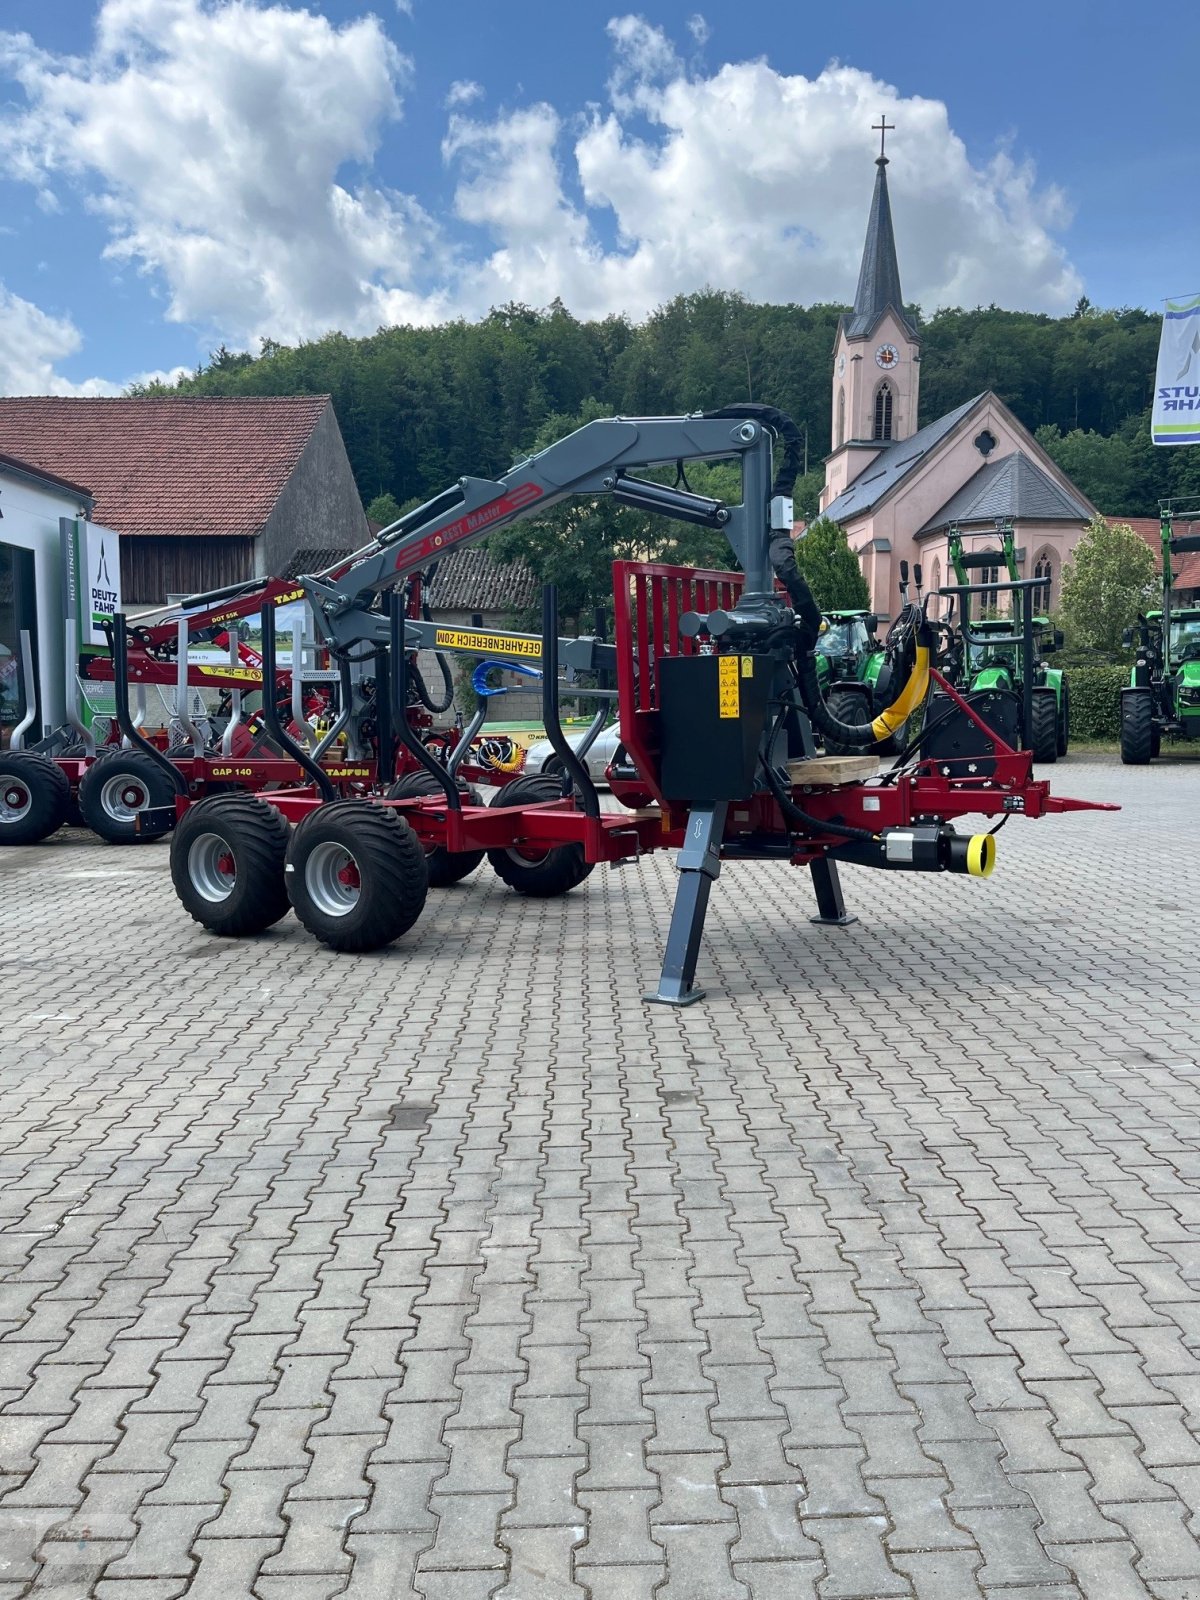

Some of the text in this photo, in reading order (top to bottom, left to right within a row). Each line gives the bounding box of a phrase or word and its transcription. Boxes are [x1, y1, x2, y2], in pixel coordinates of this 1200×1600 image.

[92, 588, 118, 603] DEUTZ
[273, 589, 305, 604] TAJF
[94, 601, 116, 613] FAHR
[211, 615, 225, 623] DOT
[437, 631, 541, 655] GEFAHRENBEREICH 20M
[212, 768, 252, 776] GAP 140
[325, 768, 370, 777] TAJFUN
